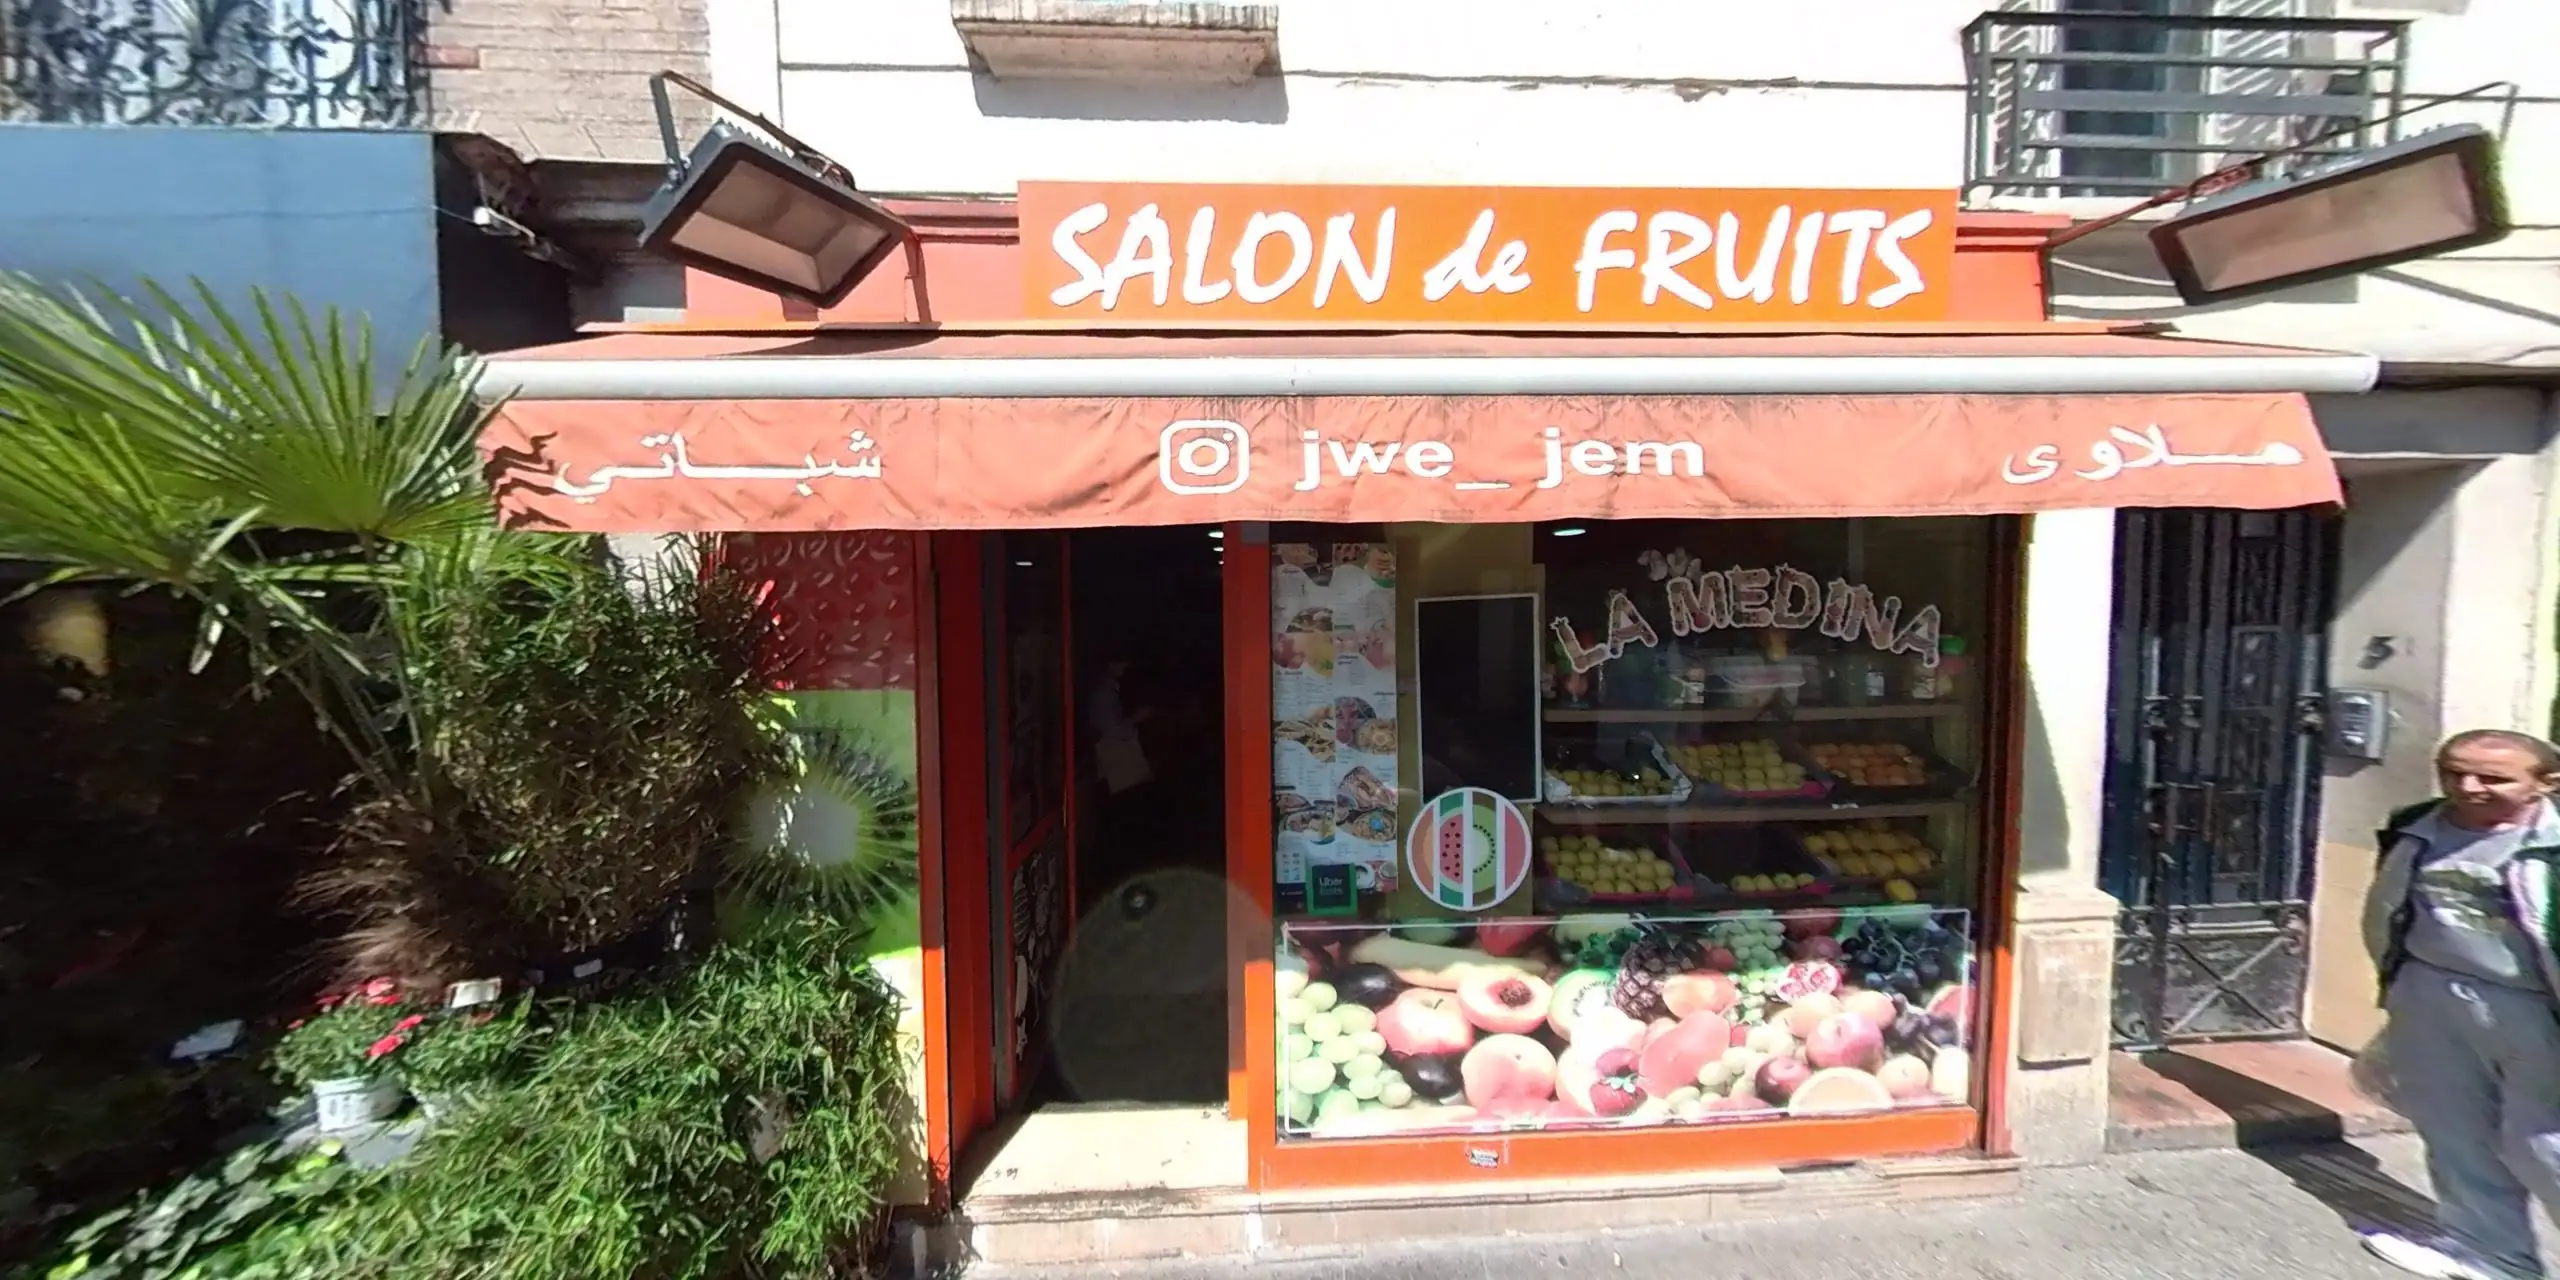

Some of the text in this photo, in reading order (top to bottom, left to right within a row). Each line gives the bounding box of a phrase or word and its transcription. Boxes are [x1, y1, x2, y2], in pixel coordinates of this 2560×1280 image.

[1049, 202, 1934, 312] SALON de FRUITS
[1538, 426, 1706, 488] jem
[1550, 562, 1941, 674] LA MEDINA
